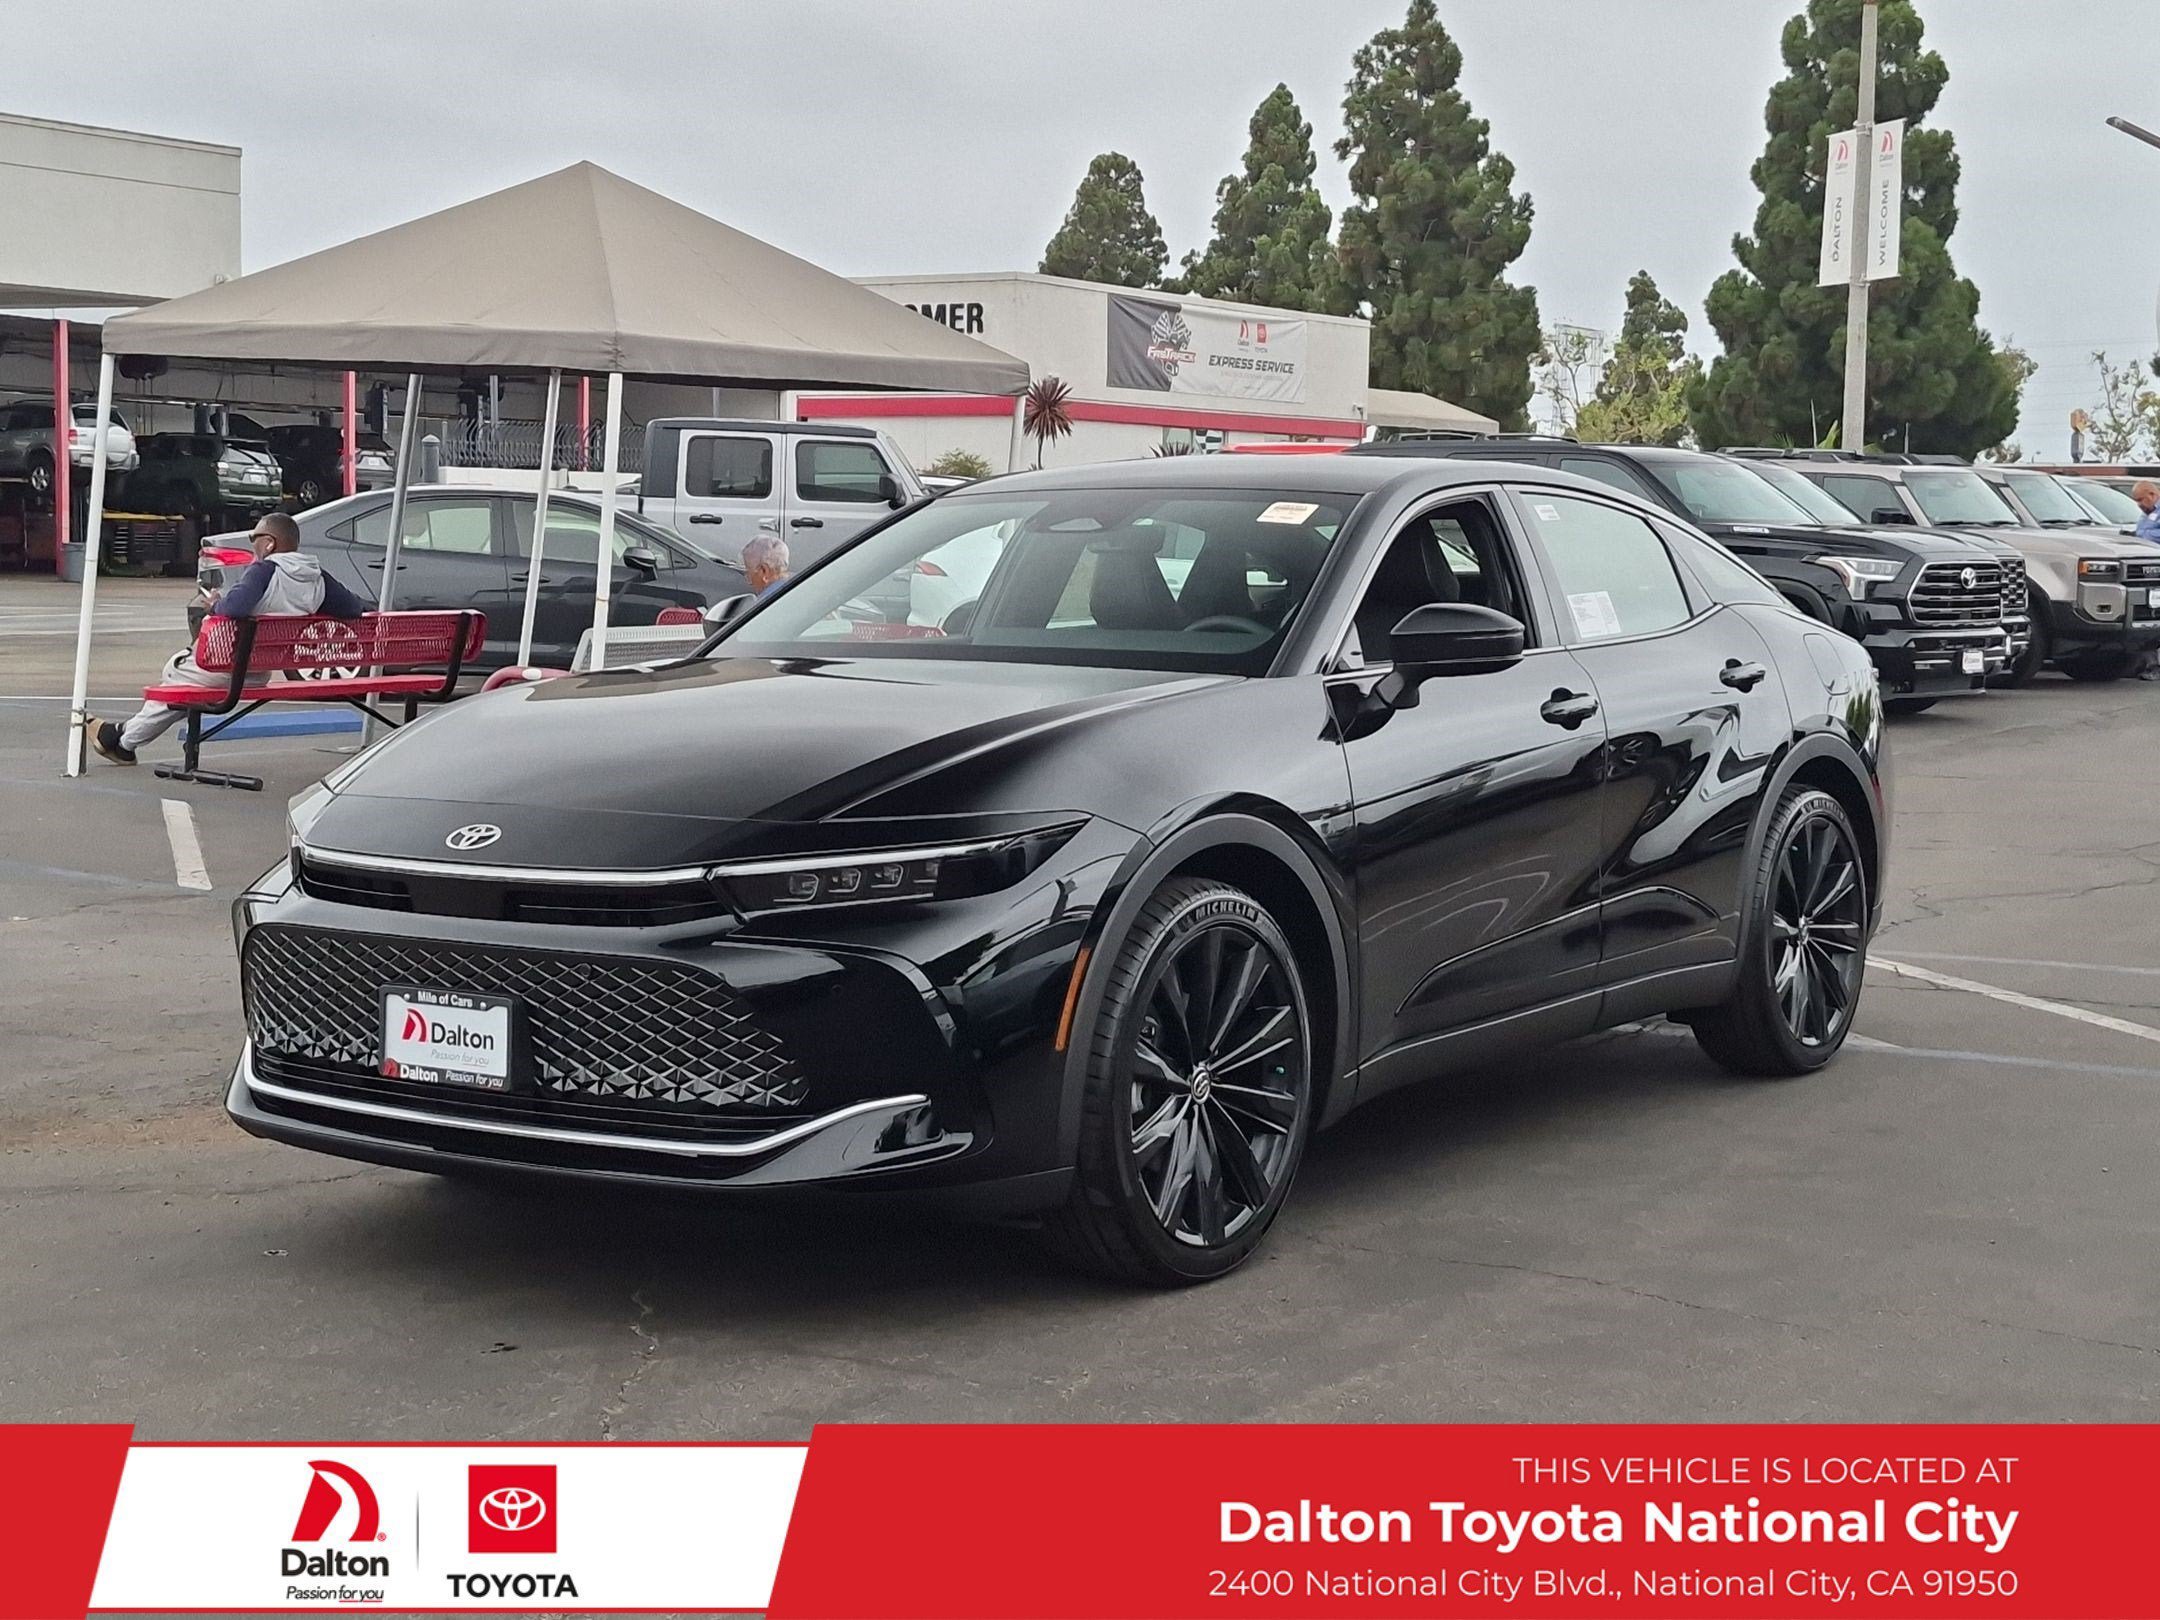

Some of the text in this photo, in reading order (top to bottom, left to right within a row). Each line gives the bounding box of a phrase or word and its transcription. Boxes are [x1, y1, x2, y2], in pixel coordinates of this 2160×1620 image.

[1832, 197, 1843, 263] DALTON
[1878, 180, 1890, 266] WELCOME
[904, 302, 984, 335] MER
[1208, 355, 1295, 375] EXPRESS SERVICE
[1195, 901, 1257, 922] MICHELIN
[417, 990, 473, 1008] Mile of Cars
[431, 1022, 495, 1051] Dalton
[430, 1048, 489, 1066] Passion for you
[400, 1064, 504, 1089] Dalton Passion for you
